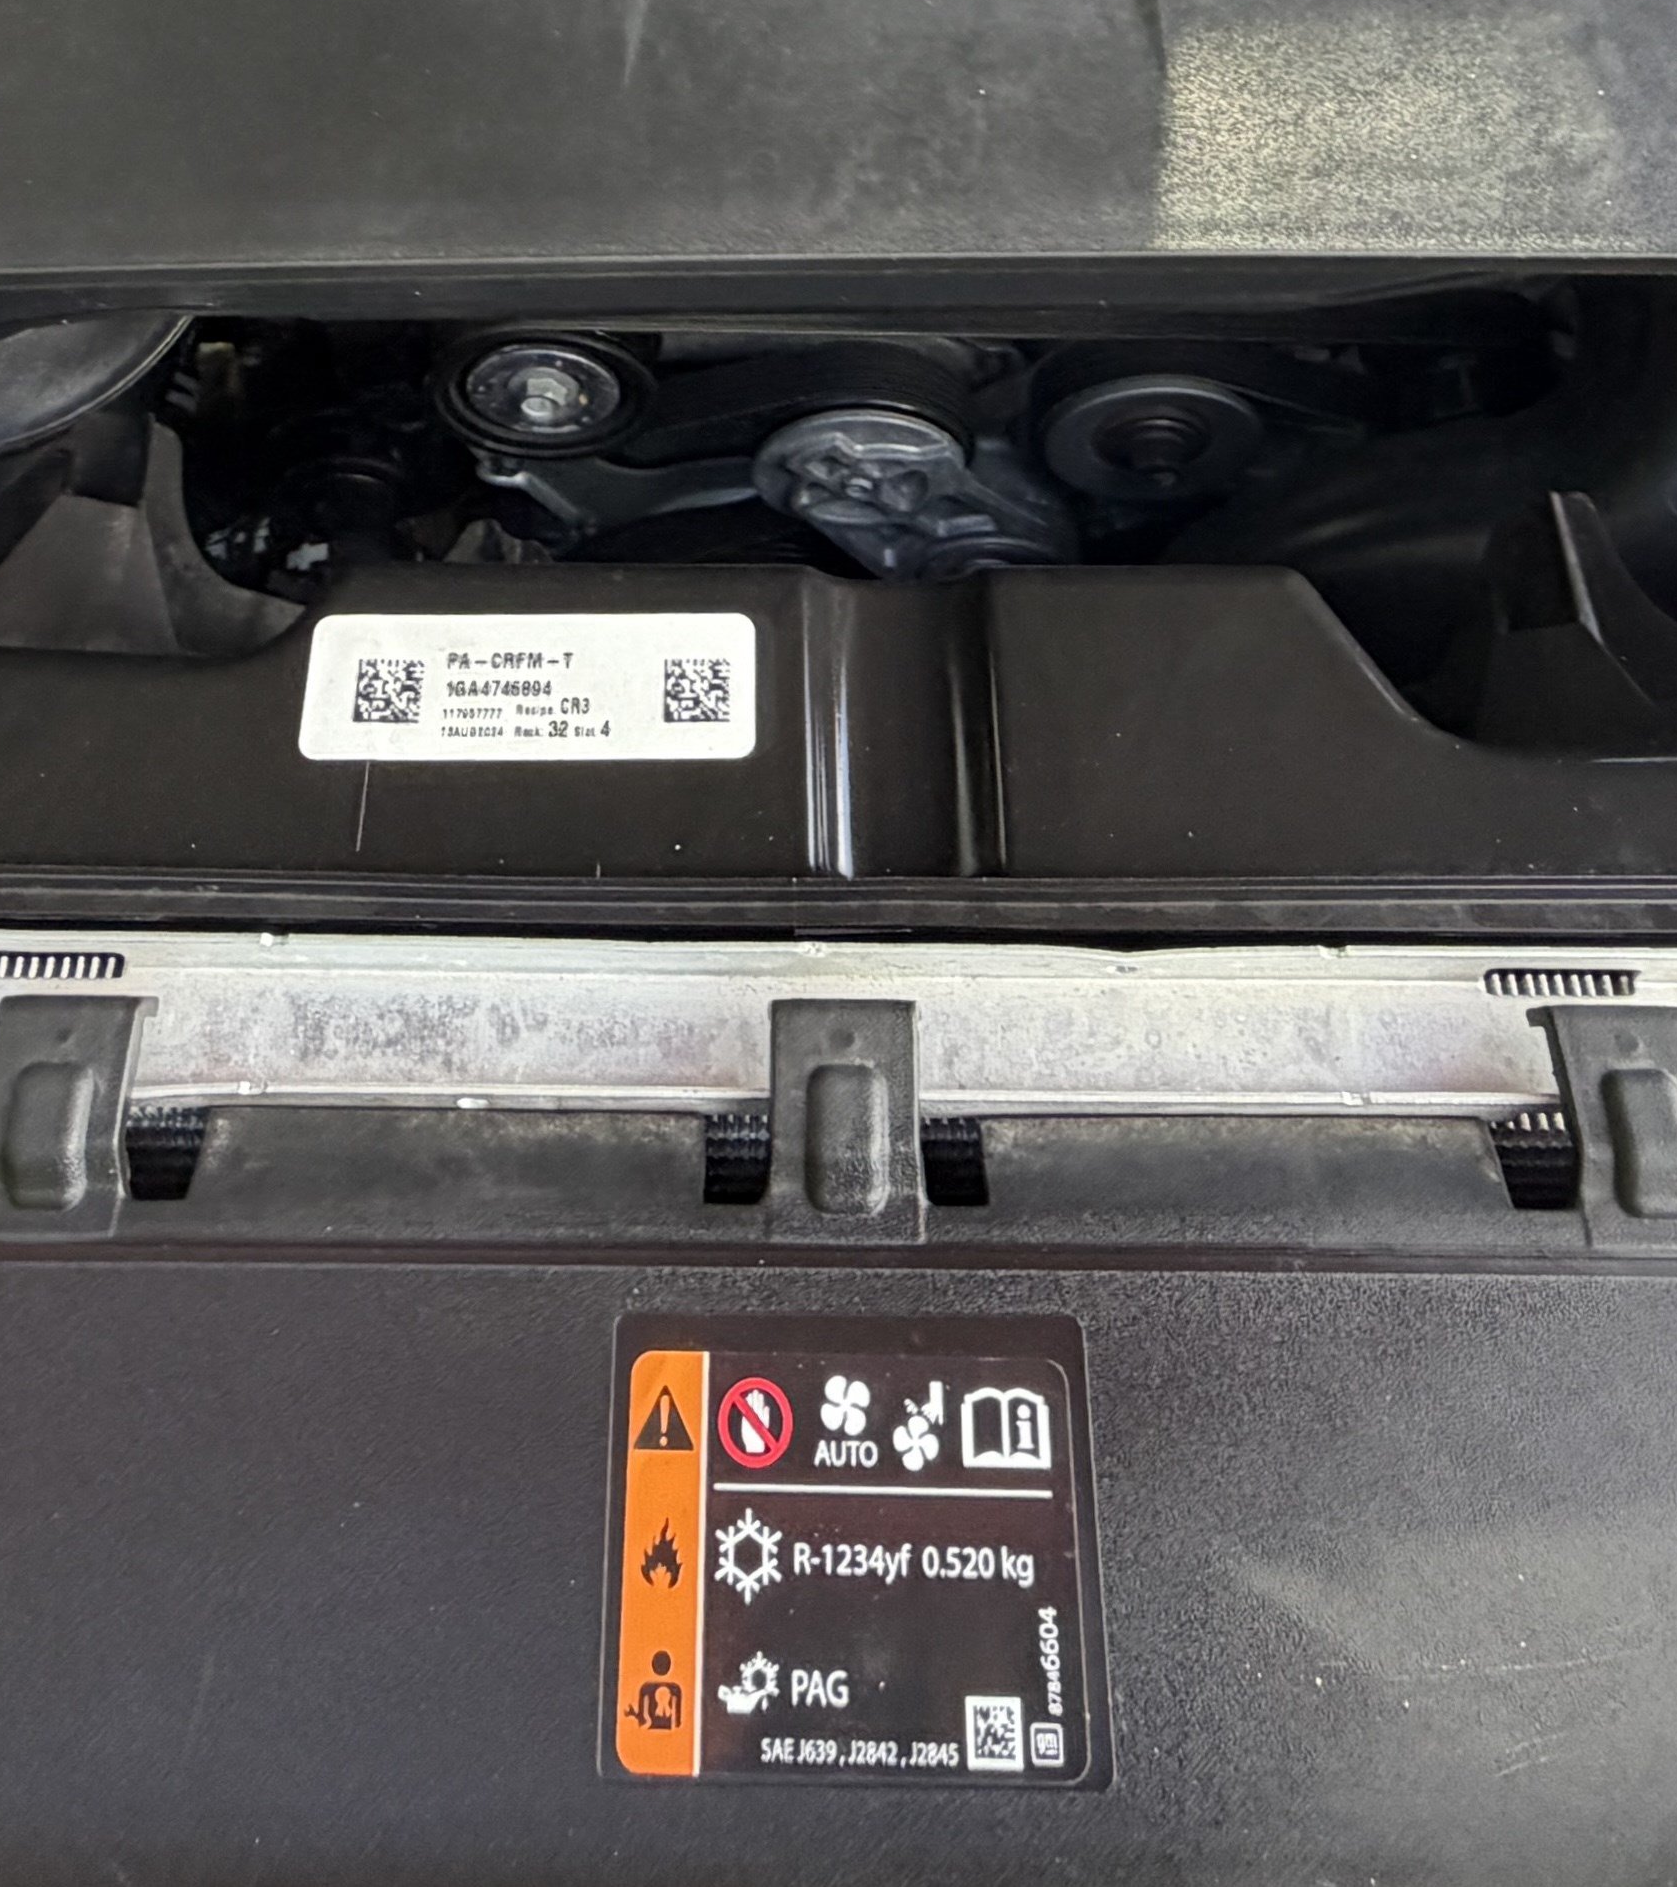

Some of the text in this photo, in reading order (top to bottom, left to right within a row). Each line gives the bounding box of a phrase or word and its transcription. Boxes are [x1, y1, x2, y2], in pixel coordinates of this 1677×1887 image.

[560, 696, 591, 715] CR3
[547, 719, 570, 739] 32
[599, 719, 612, 738] 4
[813, 1440, 879, 1467] AUTO
[792, 1541, 1035, 1589] R-1234yf 0.520 kg
[790, 1668, 851, 1709] PAG
[760, 1737, 795, 1763] SAE
[909, 1741, 960, 1766] J2845
